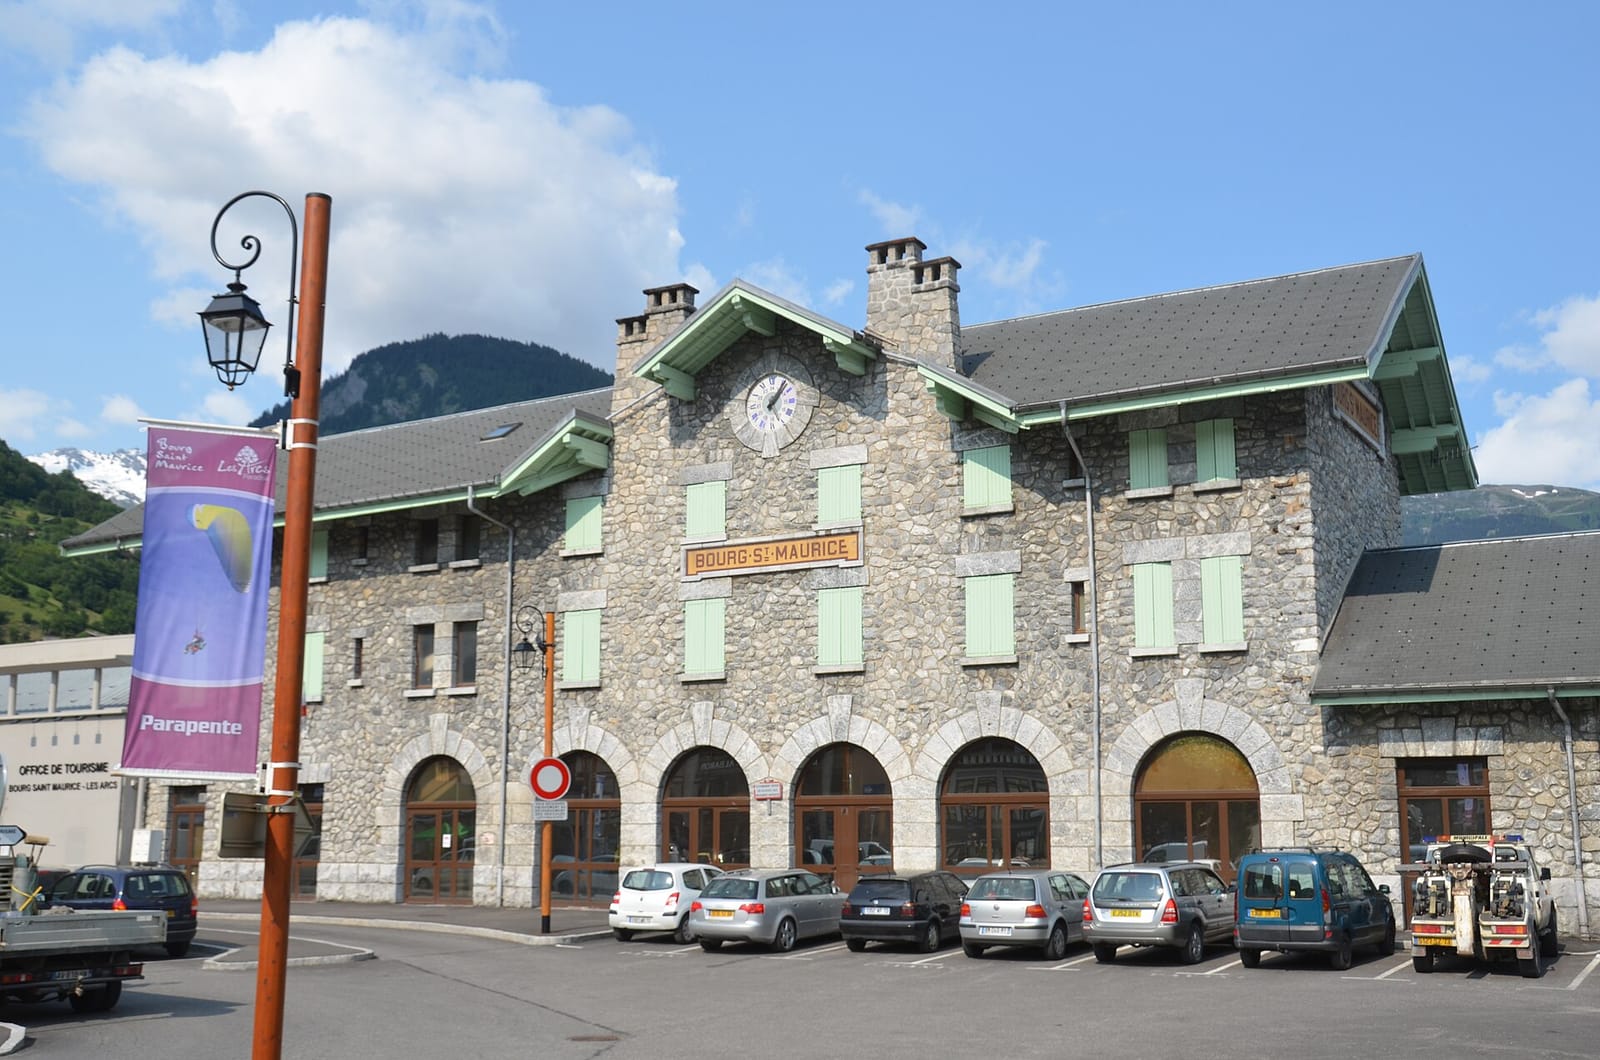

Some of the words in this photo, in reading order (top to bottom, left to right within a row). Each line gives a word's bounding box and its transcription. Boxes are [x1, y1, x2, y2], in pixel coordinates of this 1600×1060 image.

[156, 437, 193, 454] Bourg
[155, 450, 188, 461] Saint
[155, 460, 205, 473] Maurice
[217, 460, 238, 473] Les
[775, 539, 849, 561] MAURICE
[140, 714, 243, 736] Parapente
[19, 765, 49, 776] OFFICE
[51, 764, 63, 775] DE
[65, 762, 109, 773] TOURISME
[9, 784, 31, 793] BOURG
[32, 783, 51, 792] SAINT
[52, 782, 81, 791] MAURICE
[87, 781, 99, 790] LES
[100, 781, 118, 789] ARCS
